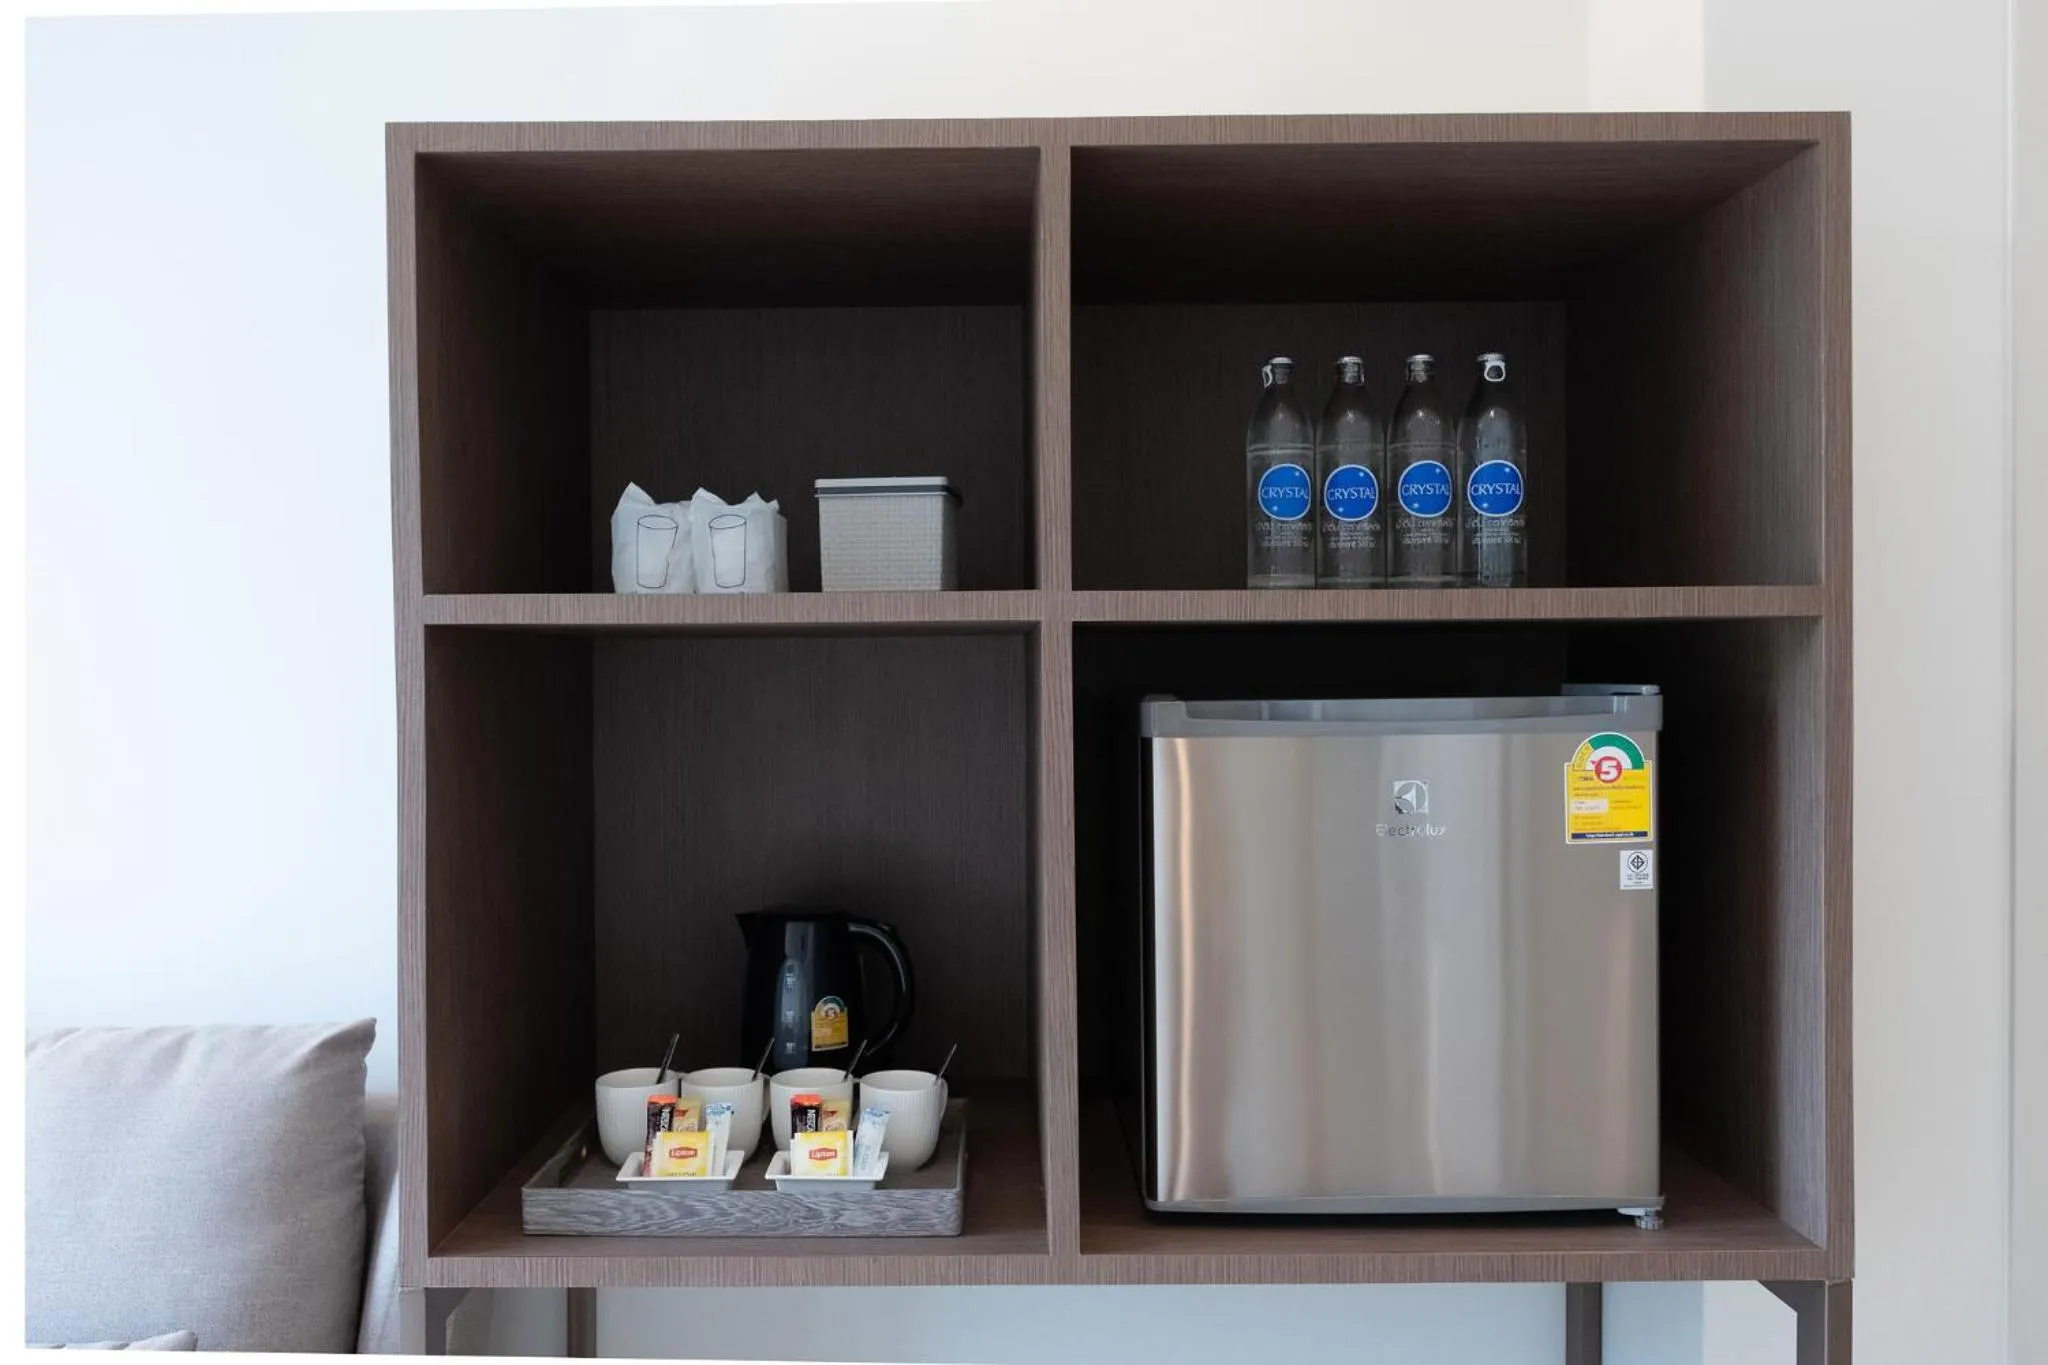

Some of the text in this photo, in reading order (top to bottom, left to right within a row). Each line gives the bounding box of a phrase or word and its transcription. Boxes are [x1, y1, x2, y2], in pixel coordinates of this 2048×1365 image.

[1327, 487, 1376, 500] CRYSTAL
[1471, 483, 1521, 496] CRYSTAL
[1600, 760, 1618, 781] 5
